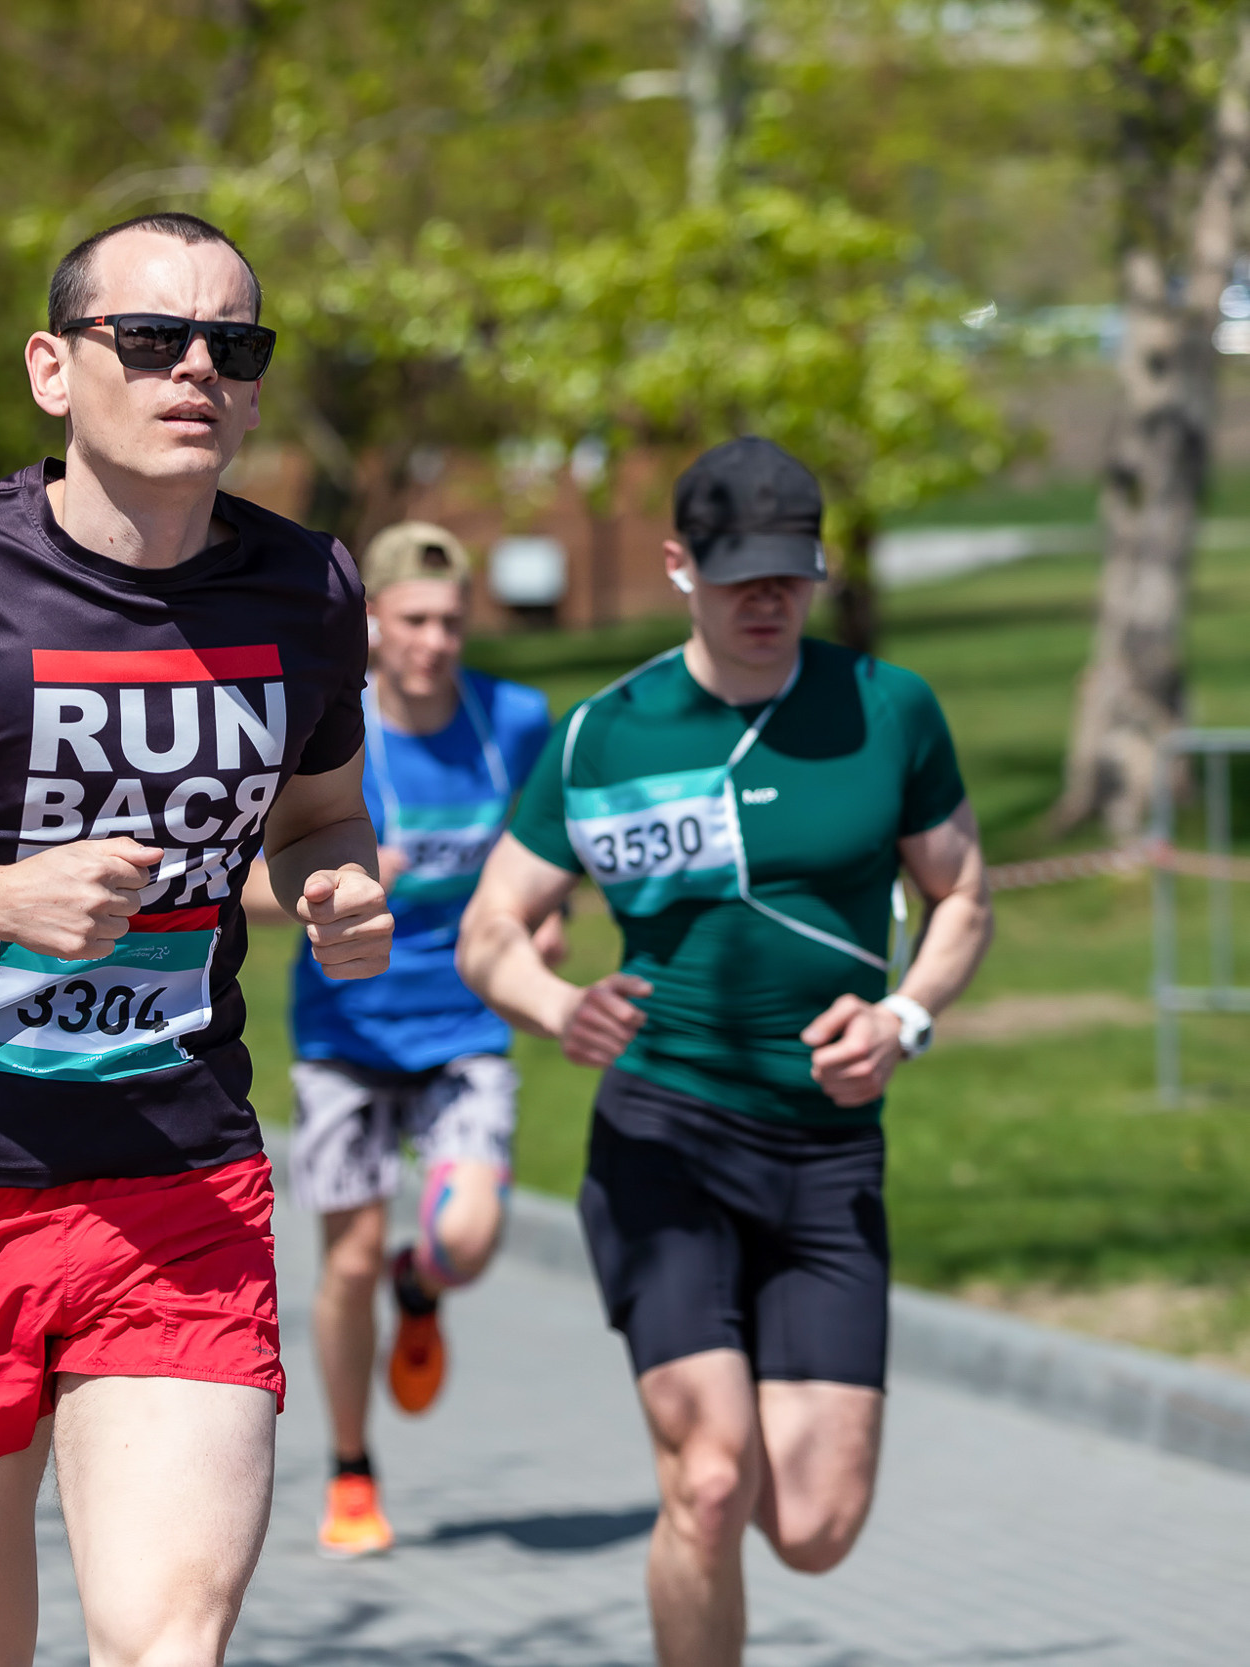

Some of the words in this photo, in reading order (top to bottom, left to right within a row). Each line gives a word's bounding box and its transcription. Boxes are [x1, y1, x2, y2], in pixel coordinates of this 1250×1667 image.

[28, 681, 287, 774] RUN
[593, 816, 703, 873] 3530
[16, 979, 170, 1036] 3304
